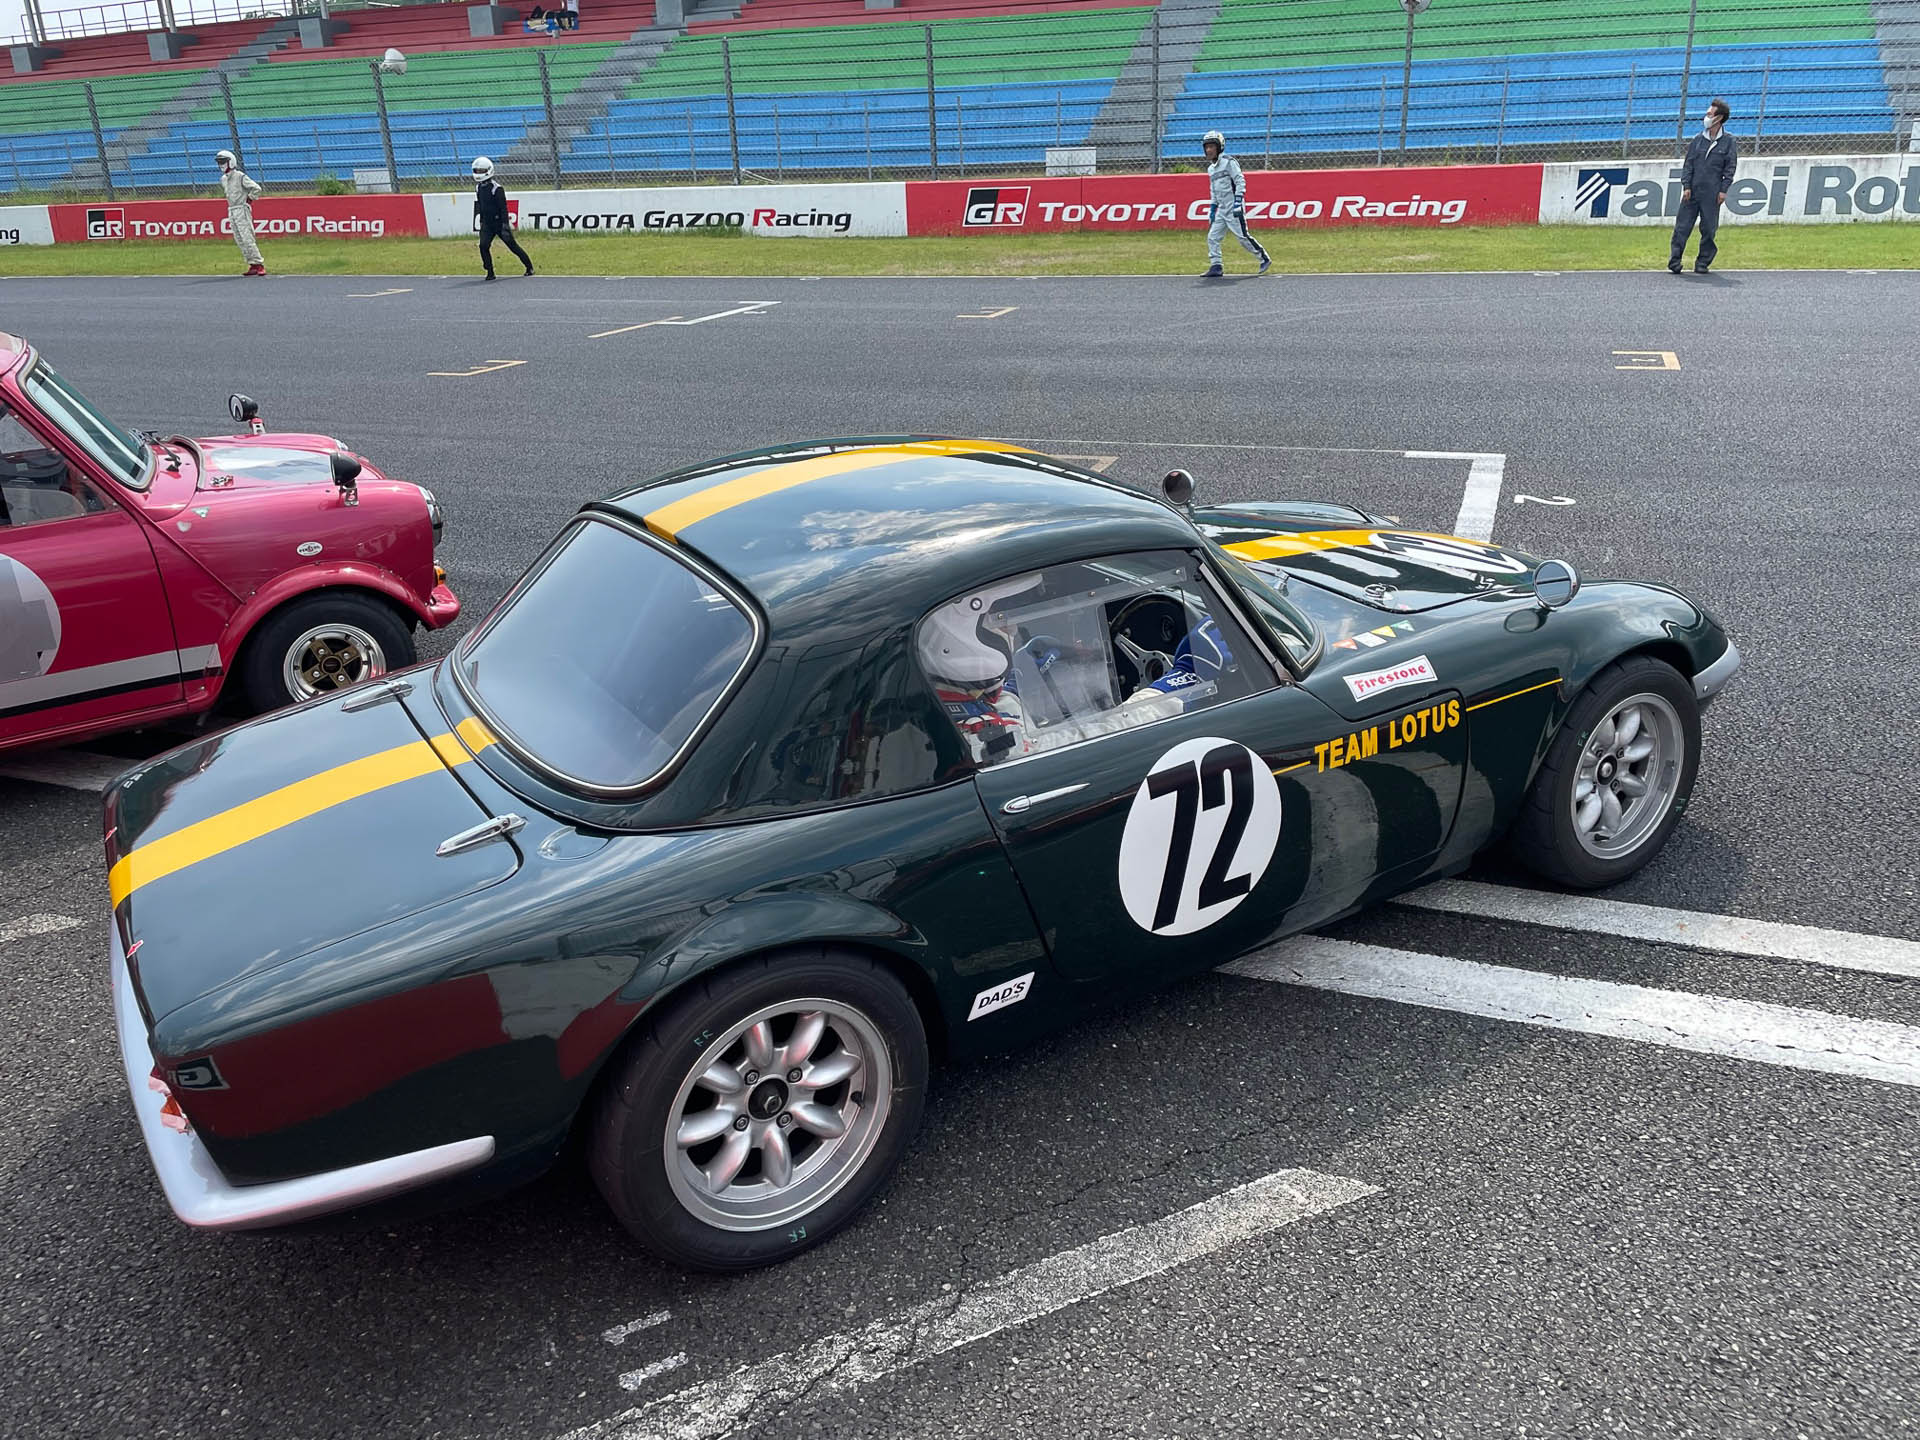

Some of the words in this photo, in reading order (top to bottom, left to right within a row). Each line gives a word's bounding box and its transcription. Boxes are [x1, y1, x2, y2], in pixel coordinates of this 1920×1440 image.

[1575, 165, 1790, 218] Taiei
[528, 212, 636, 230] TOYOTA
[752, 208, 852, 232] Racing
[967, 202, 1024, 223] GR
[1038, 202, 1177, 222] TOYOTA
[1186, 199, 1327, 220] GZOO
[1331, 194, 1468, 223] Racing
[89, 220, 123, 237] GR
[129, 220, 215, 236] TOYOTA
[220, 217, 300, 234] GZOO
[306, 216, 385, 237] Racing
[1354, 664, 1427, 692] Firestone
[1314, 726, 1379, 774] TEAM
[1389, 699, 1461, 750] LOTUS
[1146, 743, 1255, 932] 72
[978, 981, 1026, 1010] DAD'S
